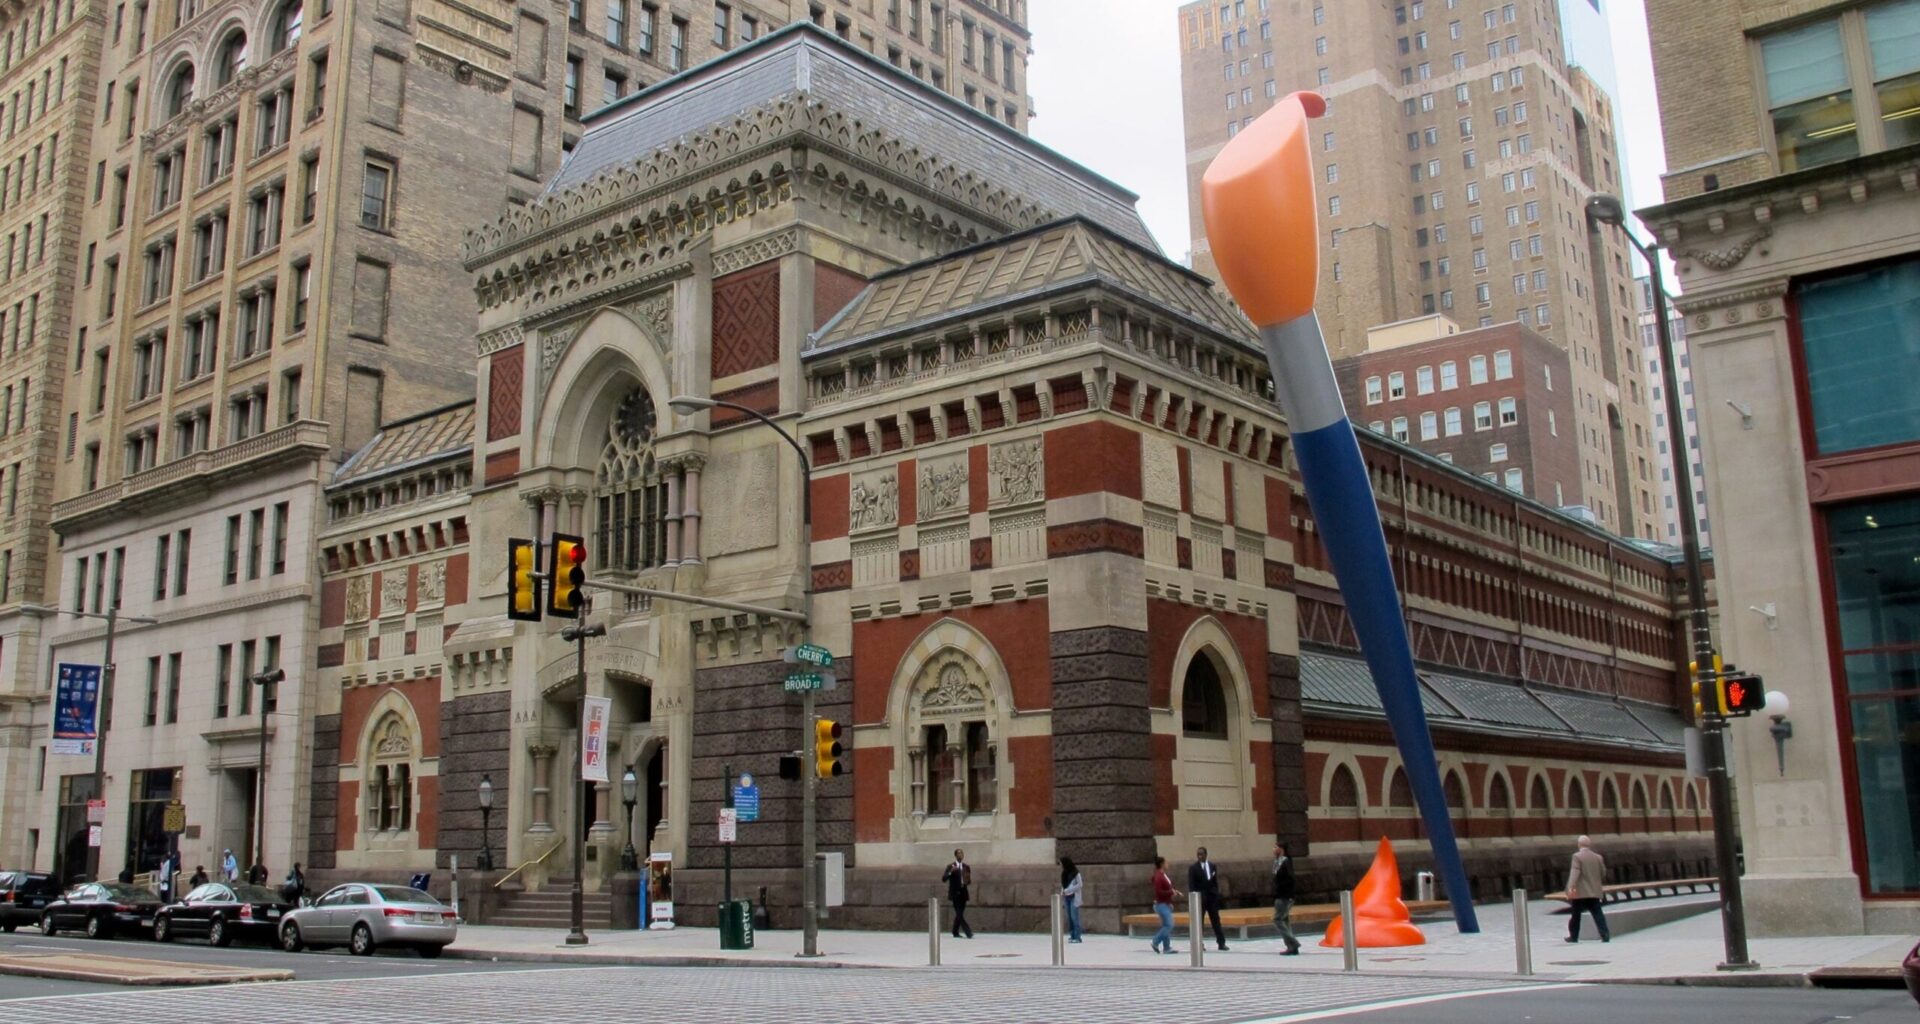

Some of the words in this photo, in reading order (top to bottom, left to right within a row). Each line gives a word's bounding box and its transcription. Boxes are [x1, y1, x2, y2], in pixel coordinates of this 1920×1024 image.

[797, 648, 824, 664] CHERRY
[784, 679, 812, 691] BROAD
[812, 680, 821, 689] ST
[741, 901, 751, 944] metro
